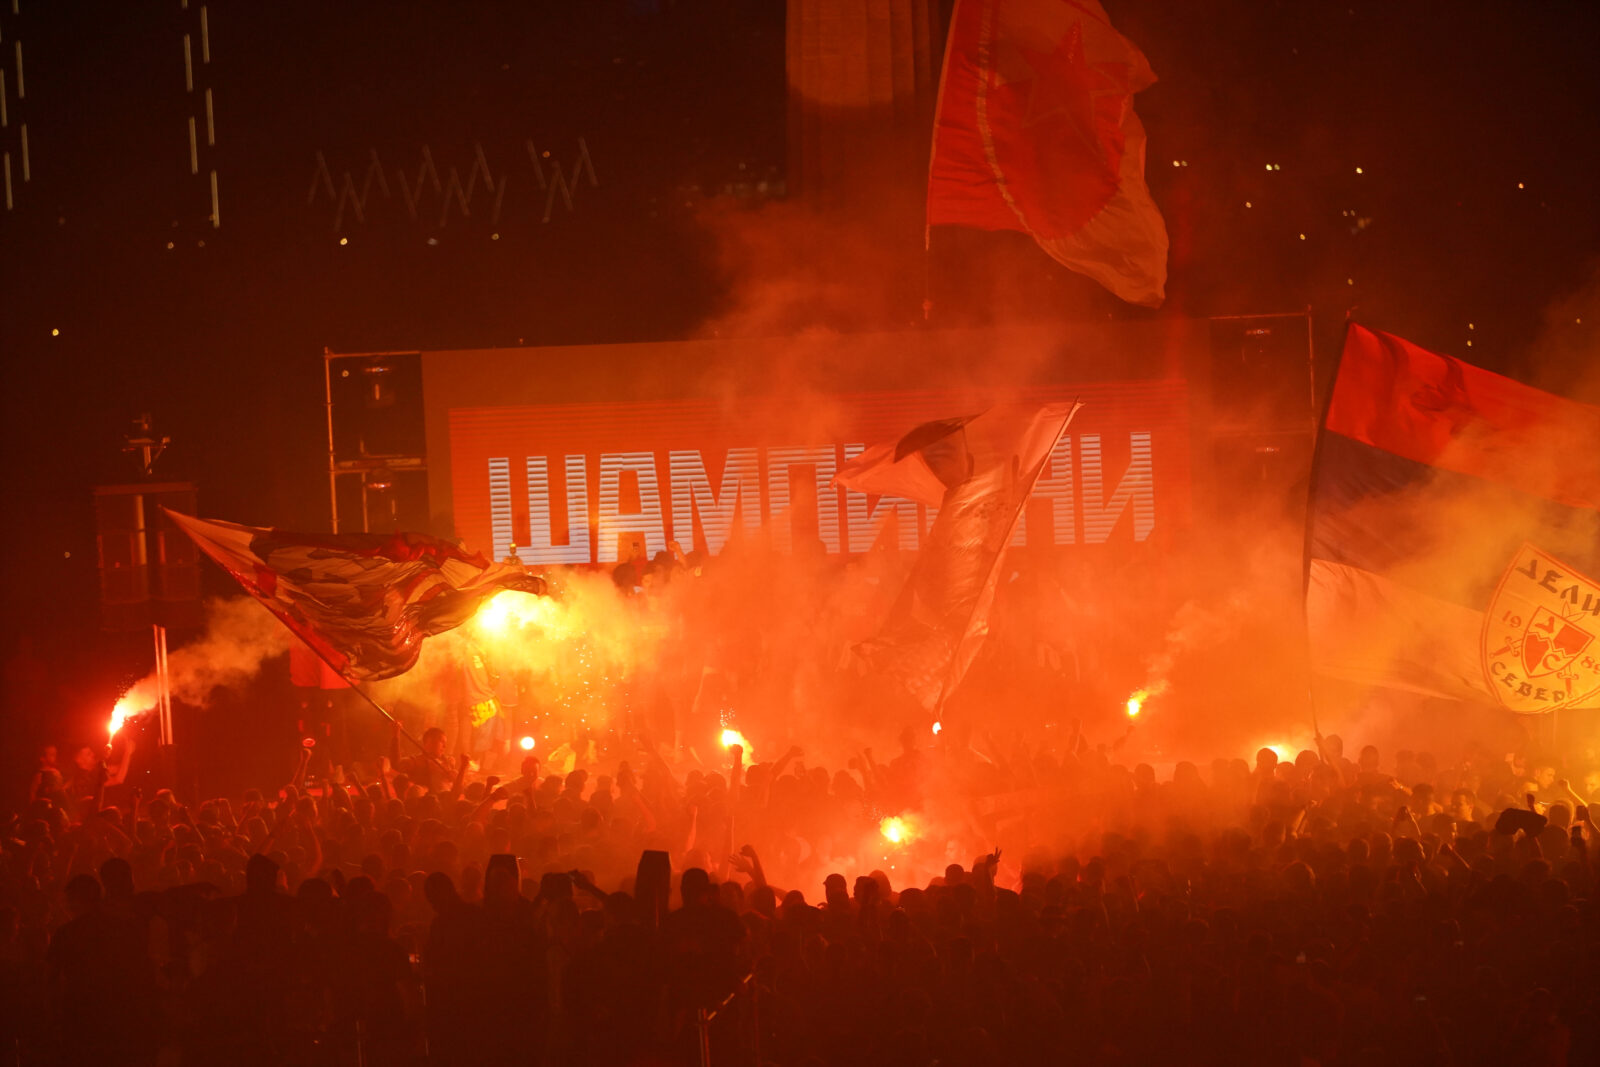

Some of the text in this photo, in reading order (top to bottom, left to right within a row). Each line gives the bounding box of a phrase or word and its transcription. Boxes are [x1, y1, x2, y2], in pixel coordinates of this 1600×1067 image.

[488, 431, 1155, 565] ШАМПИНИ
[1502, 610, 1522, 628] 19
[1491, 662, 1565, 702] СЕВЕР
